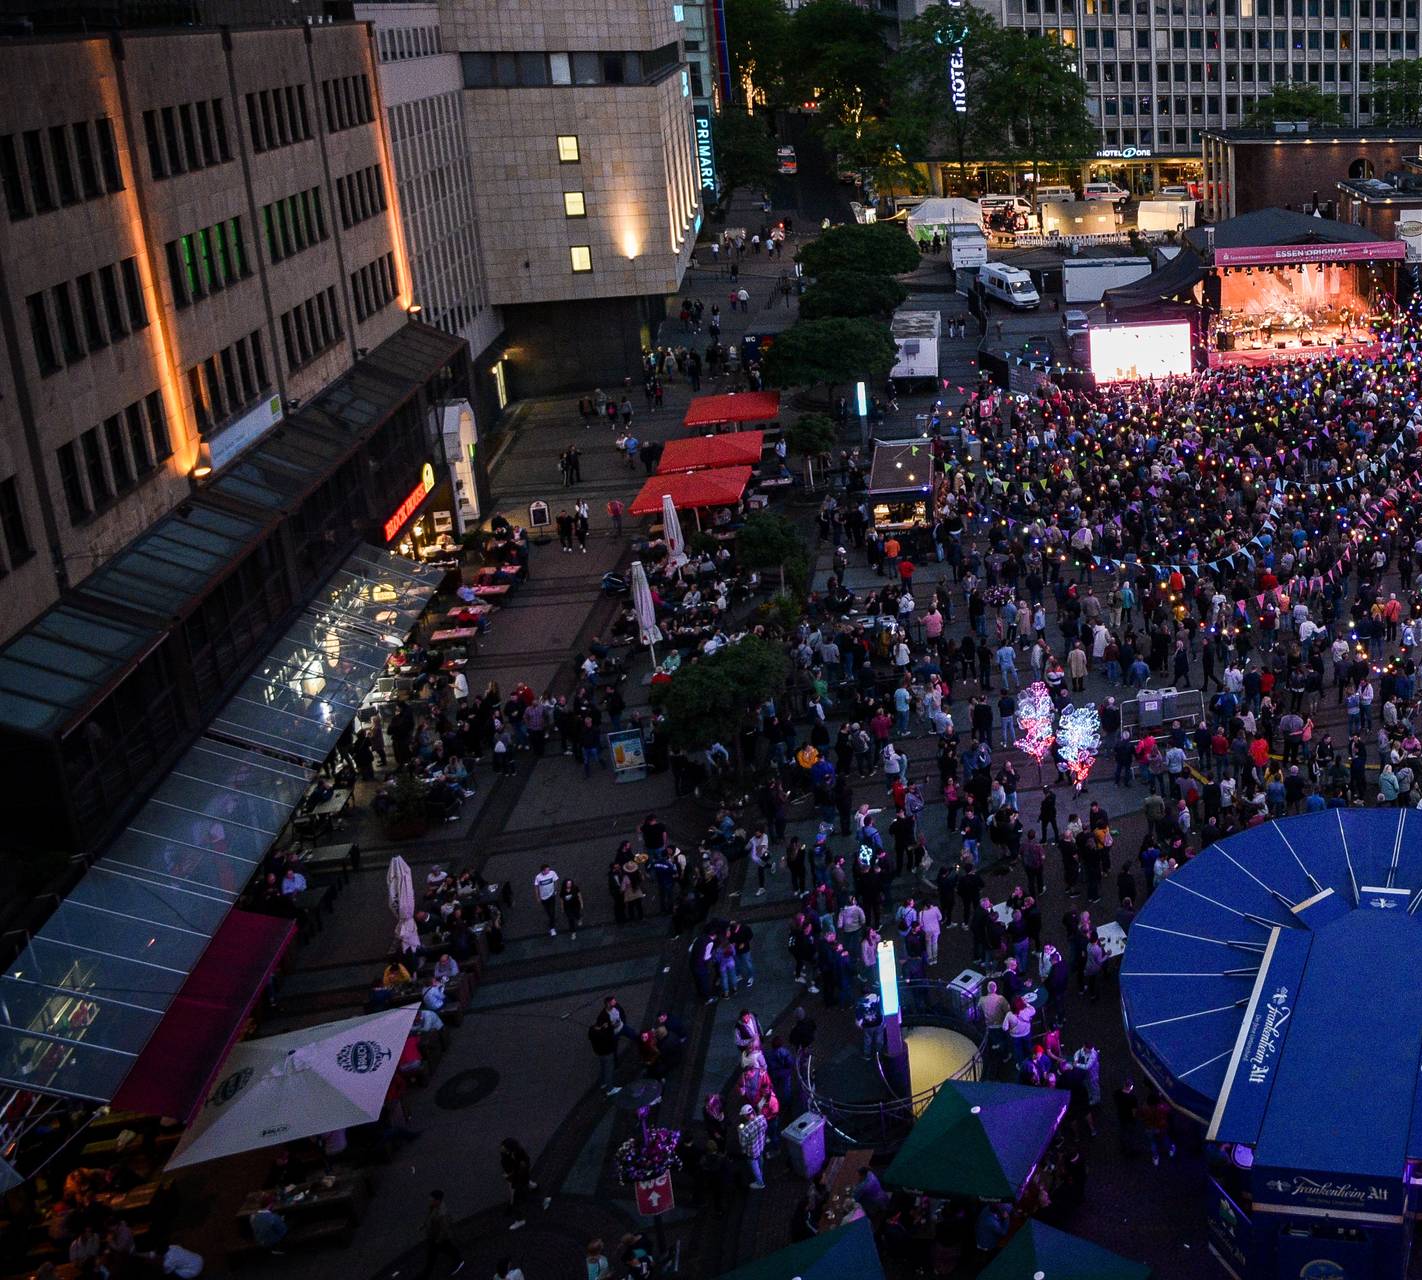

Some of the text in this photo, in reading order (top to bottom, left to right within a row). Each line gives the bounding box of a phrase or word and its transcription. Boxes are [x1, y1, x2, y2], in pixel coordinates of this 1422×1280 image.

[696, 119, 714, 190] PRIMARK
[1275, 247, 1349, 258] ESSEN ORIGINAL
[1250, 1003, 1290, 1064] Frankenheim
[1291, 1176, 1389, 1201] Frankenheim Alt
